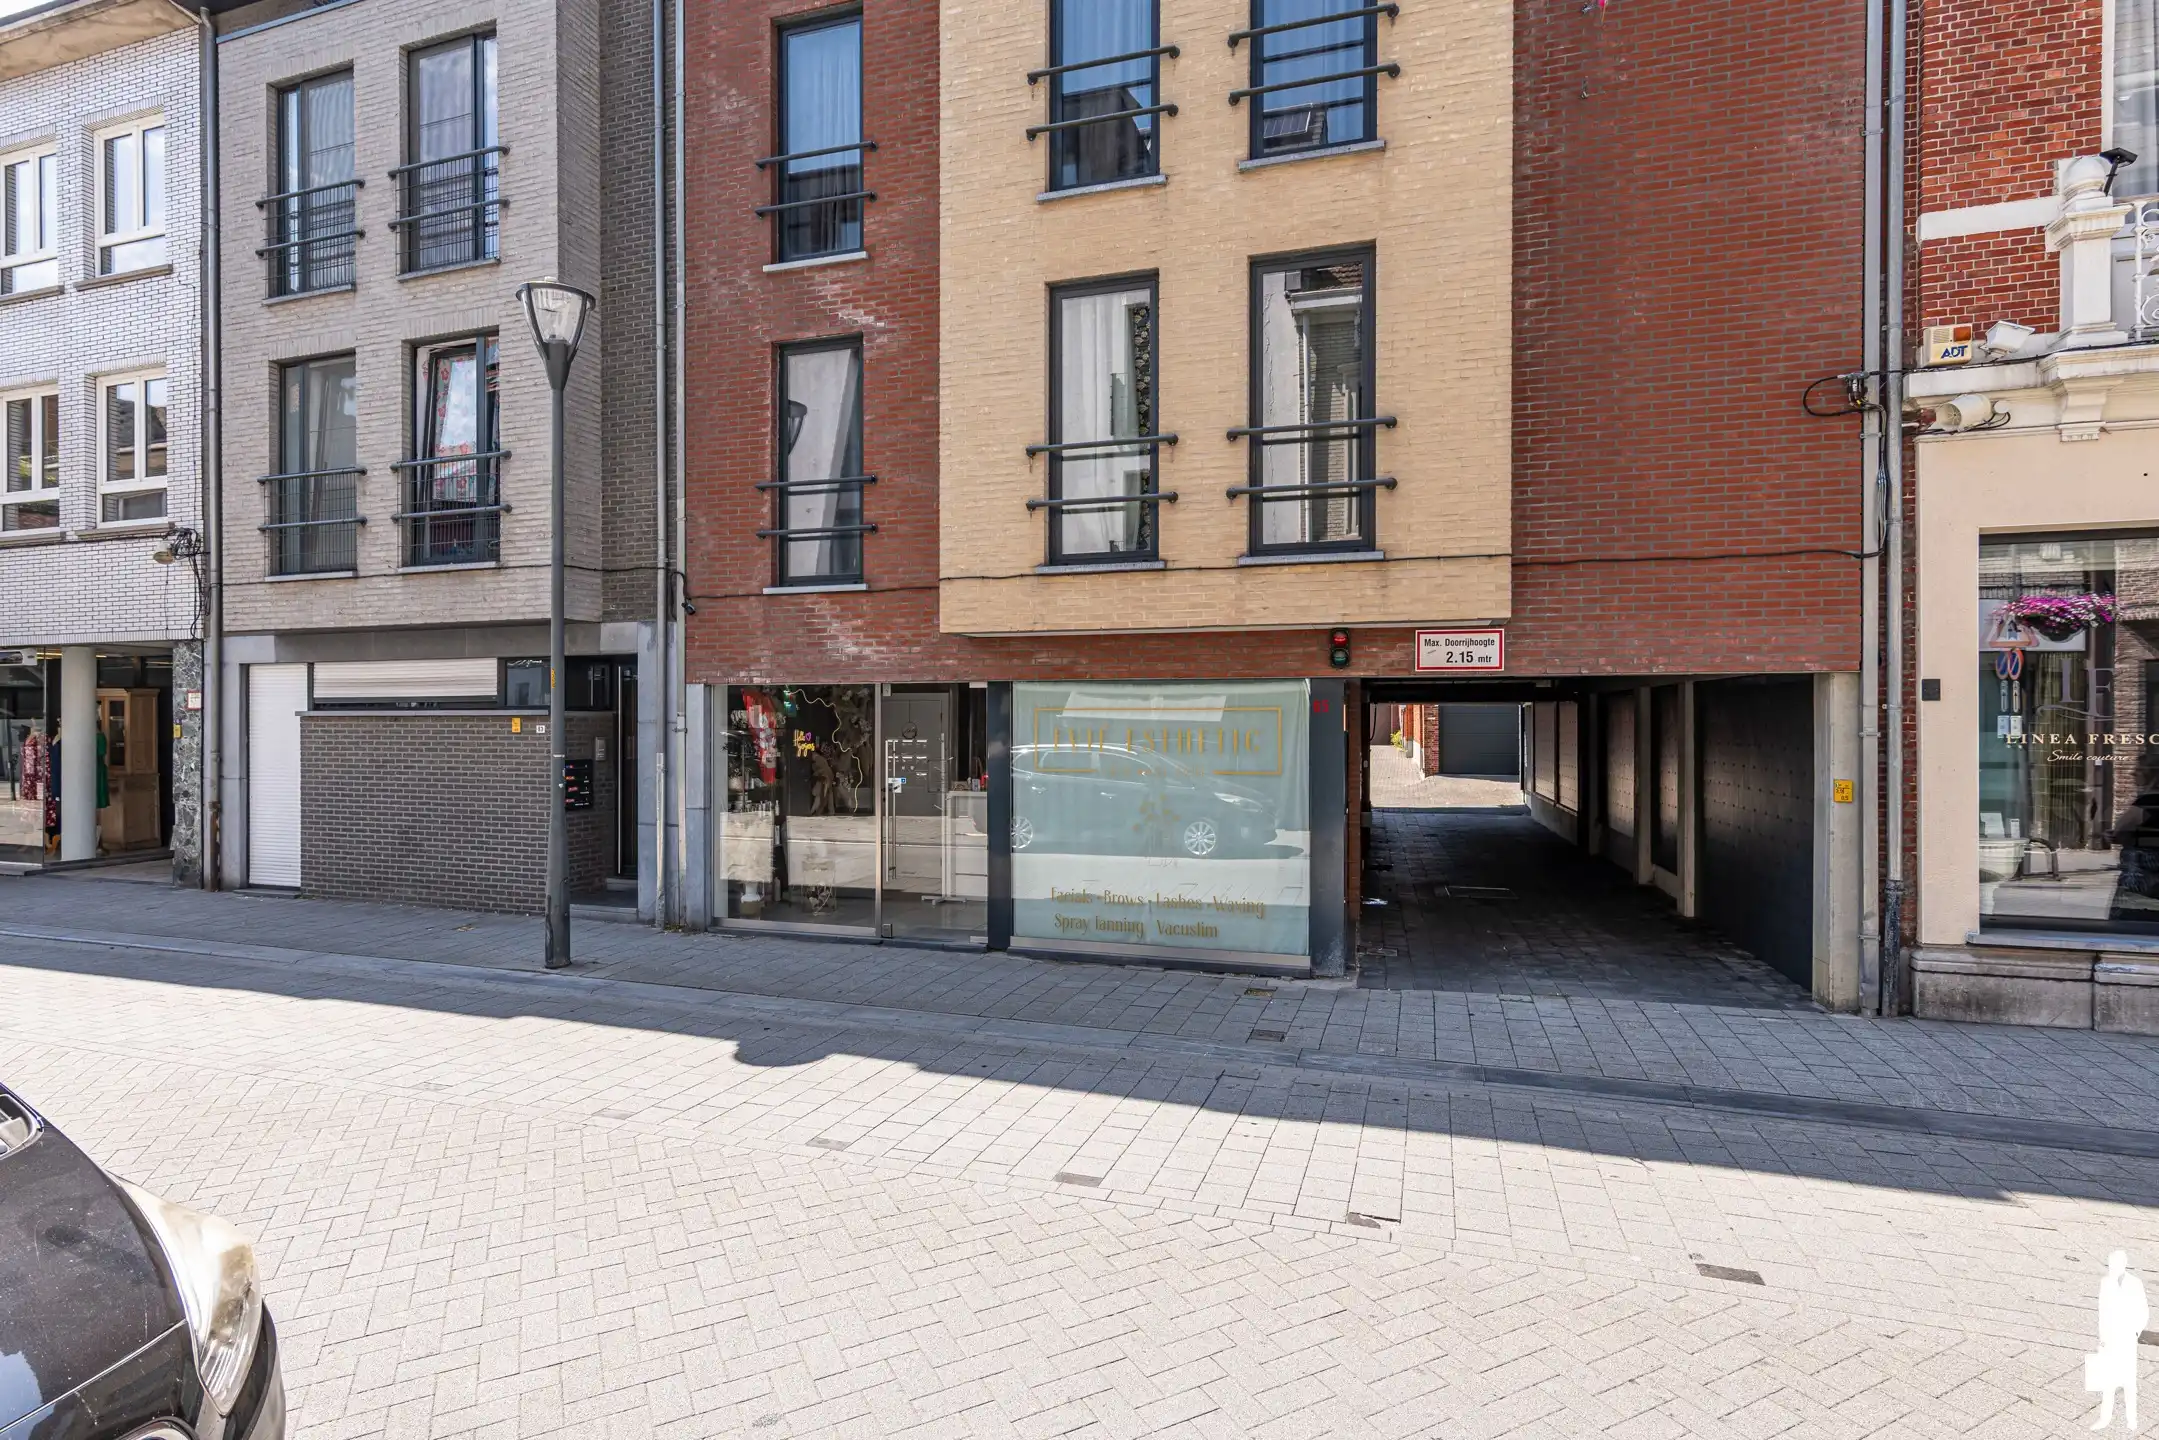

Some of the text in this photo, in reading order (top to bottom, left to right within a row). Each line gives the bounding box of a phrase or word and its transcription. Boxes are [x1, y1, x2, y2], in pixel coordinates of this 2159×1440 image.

[1941, 345, 1969, 359] ADT
[1424, 637, 1496, 648] Max. Doorrijhoogte
[1446, 651, 1493, 664] 2.15 mtr
[2006, 733, 2077, 745] LINEA
[2047, 750, 2130, 762] Smile couture
[1104, 890, 1144, 905] Brows
[1156, 893, 1202, 909] Lashes
[1213, 895, 1265, 920] Waxing
[1054, 913, 1089, 935] Spray
[1156, 919, 1219, 938] Vacuslim
